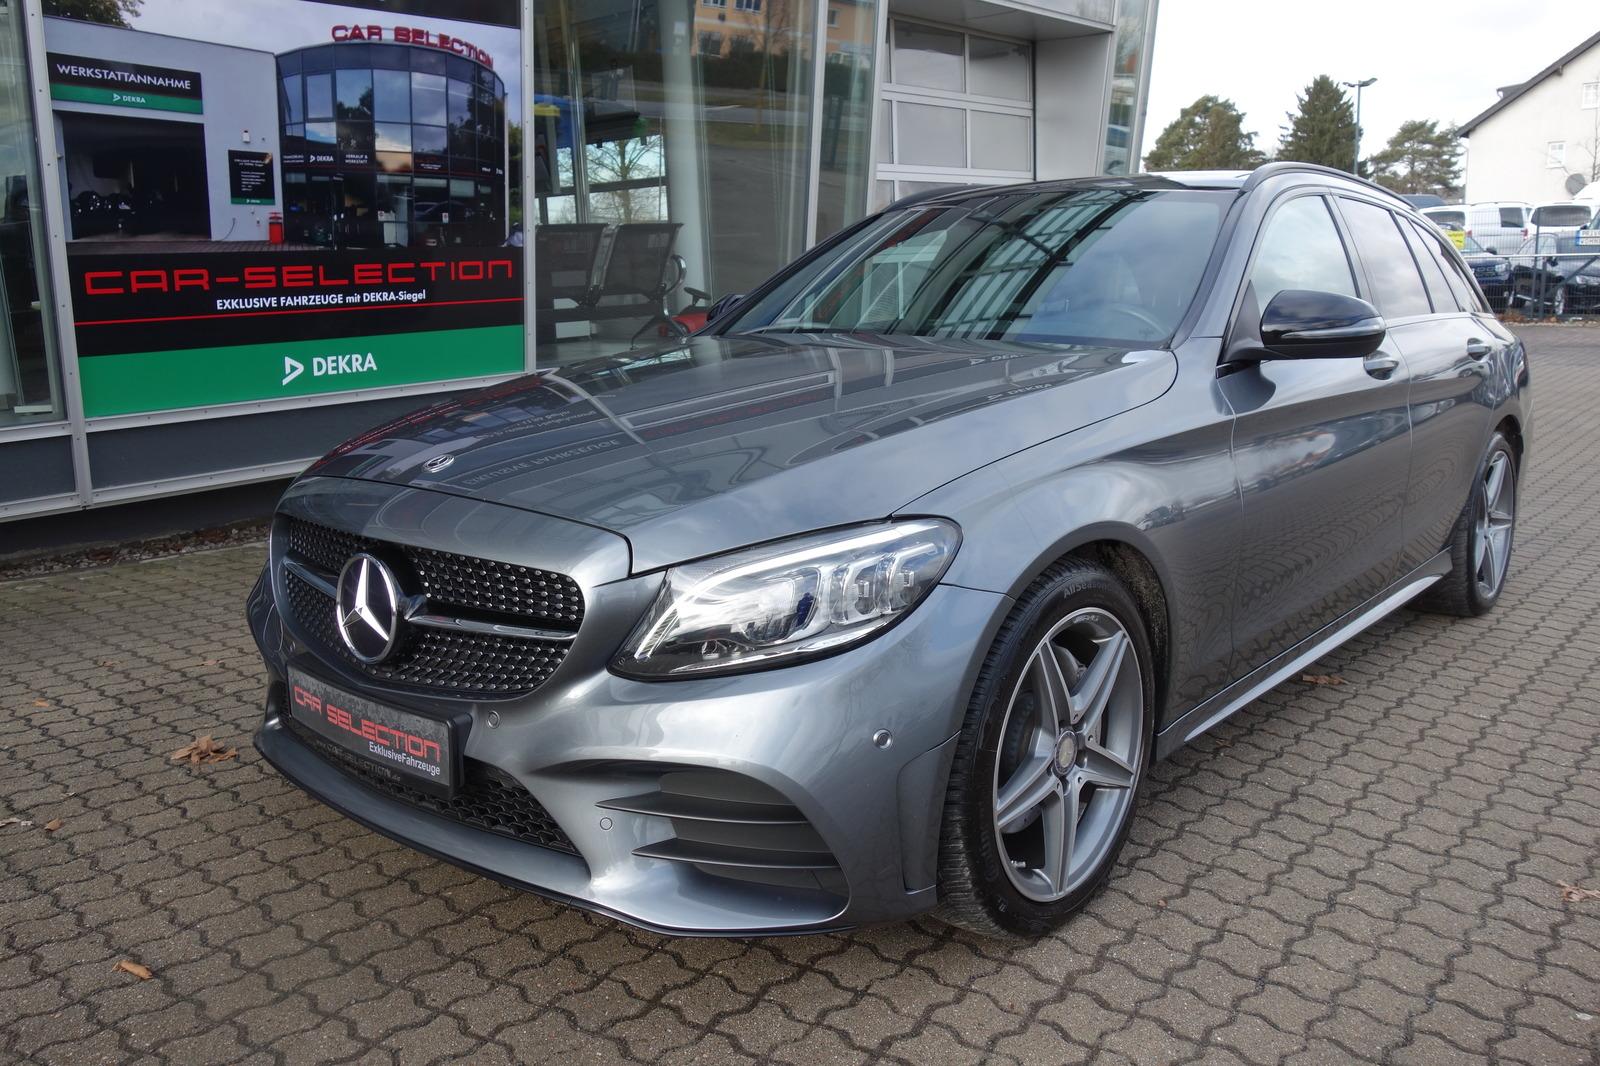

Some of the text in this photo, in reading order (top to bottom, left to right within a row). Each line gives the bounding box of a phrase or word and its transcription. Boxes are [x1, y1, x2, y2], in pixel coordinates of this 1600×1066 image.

[331, 24, 494, 71] CAR SELECTION
[56, 63, 191, 90] WERKSTATTANNAHME
[122, 96, 146, 104] DEKRA
[84, 259, 513, 295] CAR-SELECTION
[216, 289, 426, 311] EXKLUSIVE FAHRZEUGE mit DEKRA-Siegel
[312, 352, 378, 377] DEKRA
[294, 686, 440, 763] CAR SELECTION
[368, 740, 441, 777] ExklusiveFahrzeuge
